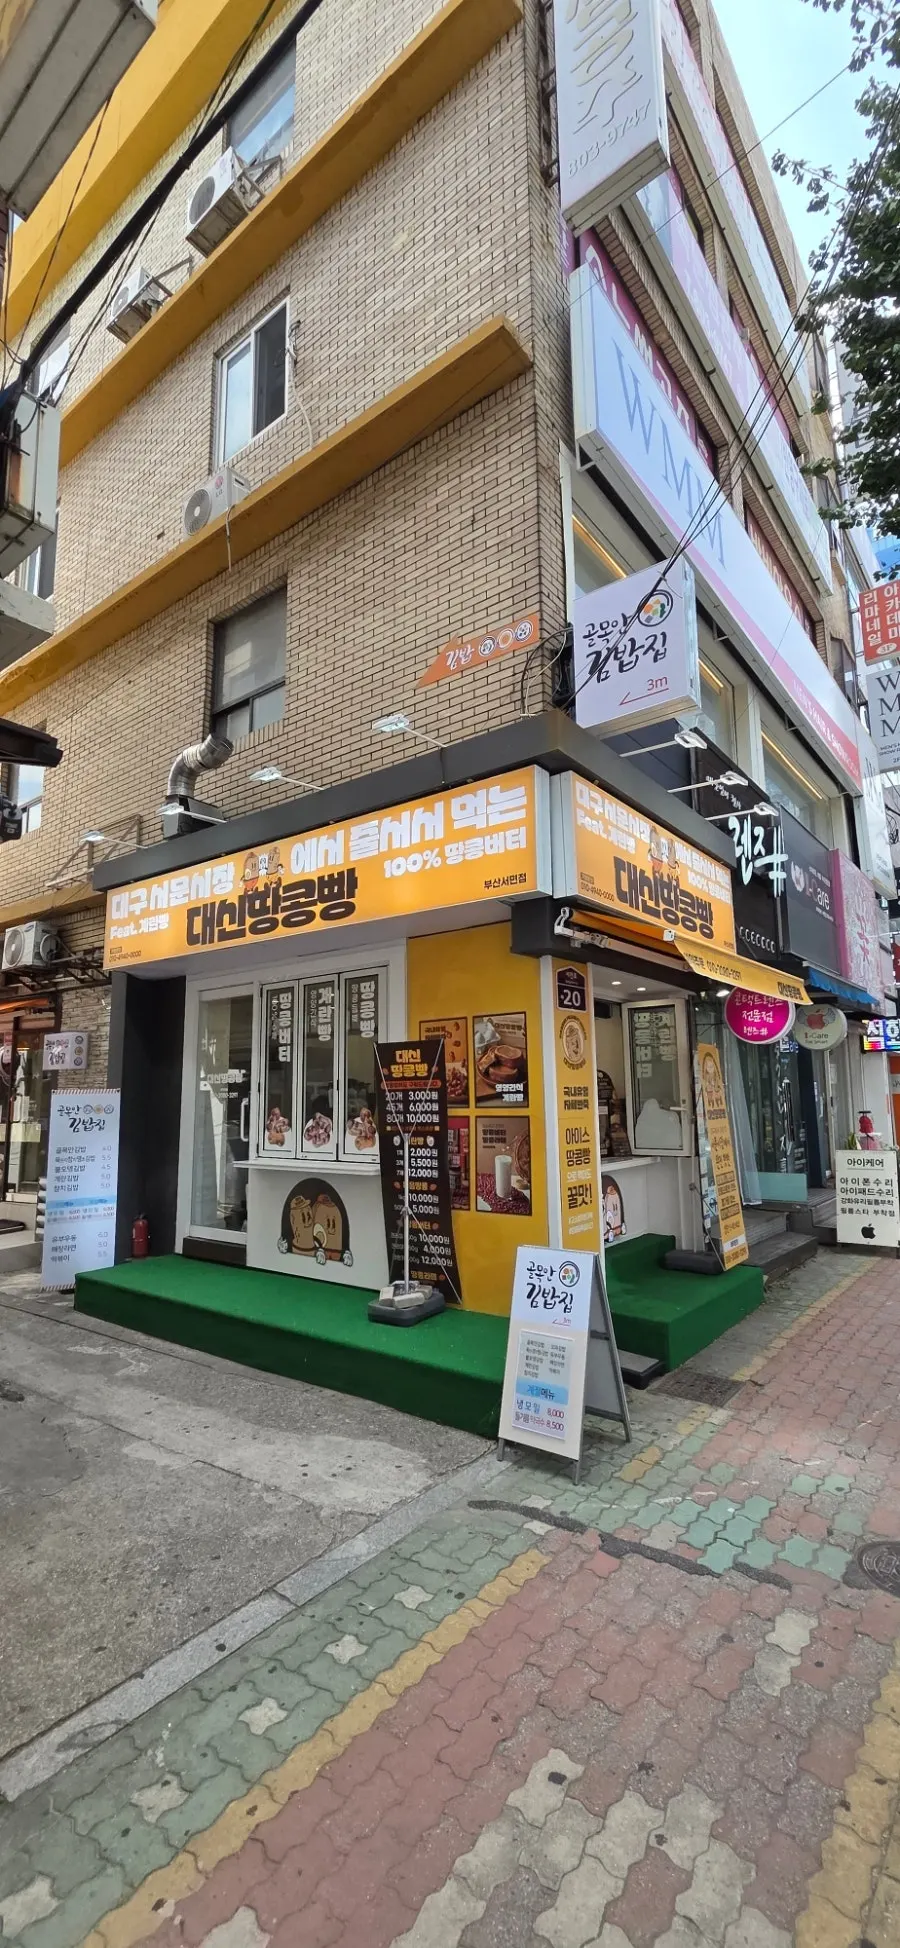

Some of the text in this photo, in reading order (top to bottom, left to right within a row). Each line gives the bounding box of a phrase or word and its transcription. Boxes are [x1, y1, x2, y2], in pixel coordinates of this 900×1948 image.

[864, 590, 882, 647] 리마네일
[583, 612, 633, 648] 골목안
[446, 644, 475, 671] 김밥
[586, 632, 667, 684] 김밥집
[647, 677, 668, 691] 3m
[290, 830, 345, 875] 에서
[349, 801, 444, 862] 줄서서
[451, 785, 527, 830] 먹는
[110, 922, 138, 940] Feat.
[384, 848, 442, 878] 100%
[444, 827, 527, 865] 땅콩버터
[484, 872, 527, 890] 부산서면점
[613, 855, 715, 940] 대신땅콩빵
[186, 867, 358, 947] 대신땅콩빵
[563, 989, 581, 1007] 20
[317, 986, 332, 1042] 계란빵
[359, 980, 376, 1039] 땅콩빵
[742, 1009, 774, 1024] 전문점
[278, 991, 293, 1063] 땅콩버터
[395, 1048, 422, 1064] 대신
[390, 1063, 428, 1078] 땅콩빵
[408, 1091, 438, 1101] 3,000원
[58, 1105, 81, 1117] 골목안
[409, 1102, 439, 1111] 6,000원
[69, 1117, 106, 1133] 김밥집
[406, 1113, 440, 1123] 10,000원
[565, 1126, 591, 1145] 아이스
[410, 1148, 438, 1157] 2,000원
[411, 1158, 438, 1168] 5,500원
[847, 1158, 885, 1168] 아이케어
[408, 1169, 439, 1179] 12,000원
[408, 1193, 439, 1204] 10,000원
[567, 1183, 593, 1210] 꿀맛!
[840, 1187, 894, 1198] 아이패드수리
[412, 1204, 440, 1215] 5,000원
[526, 1260, 556, 1282] 골목안
[526, 1282, 574, 1314] 김밥집
[547, 1407, 565, 1419] 8,000
[546, 1419, 565, 1432] 8,500
